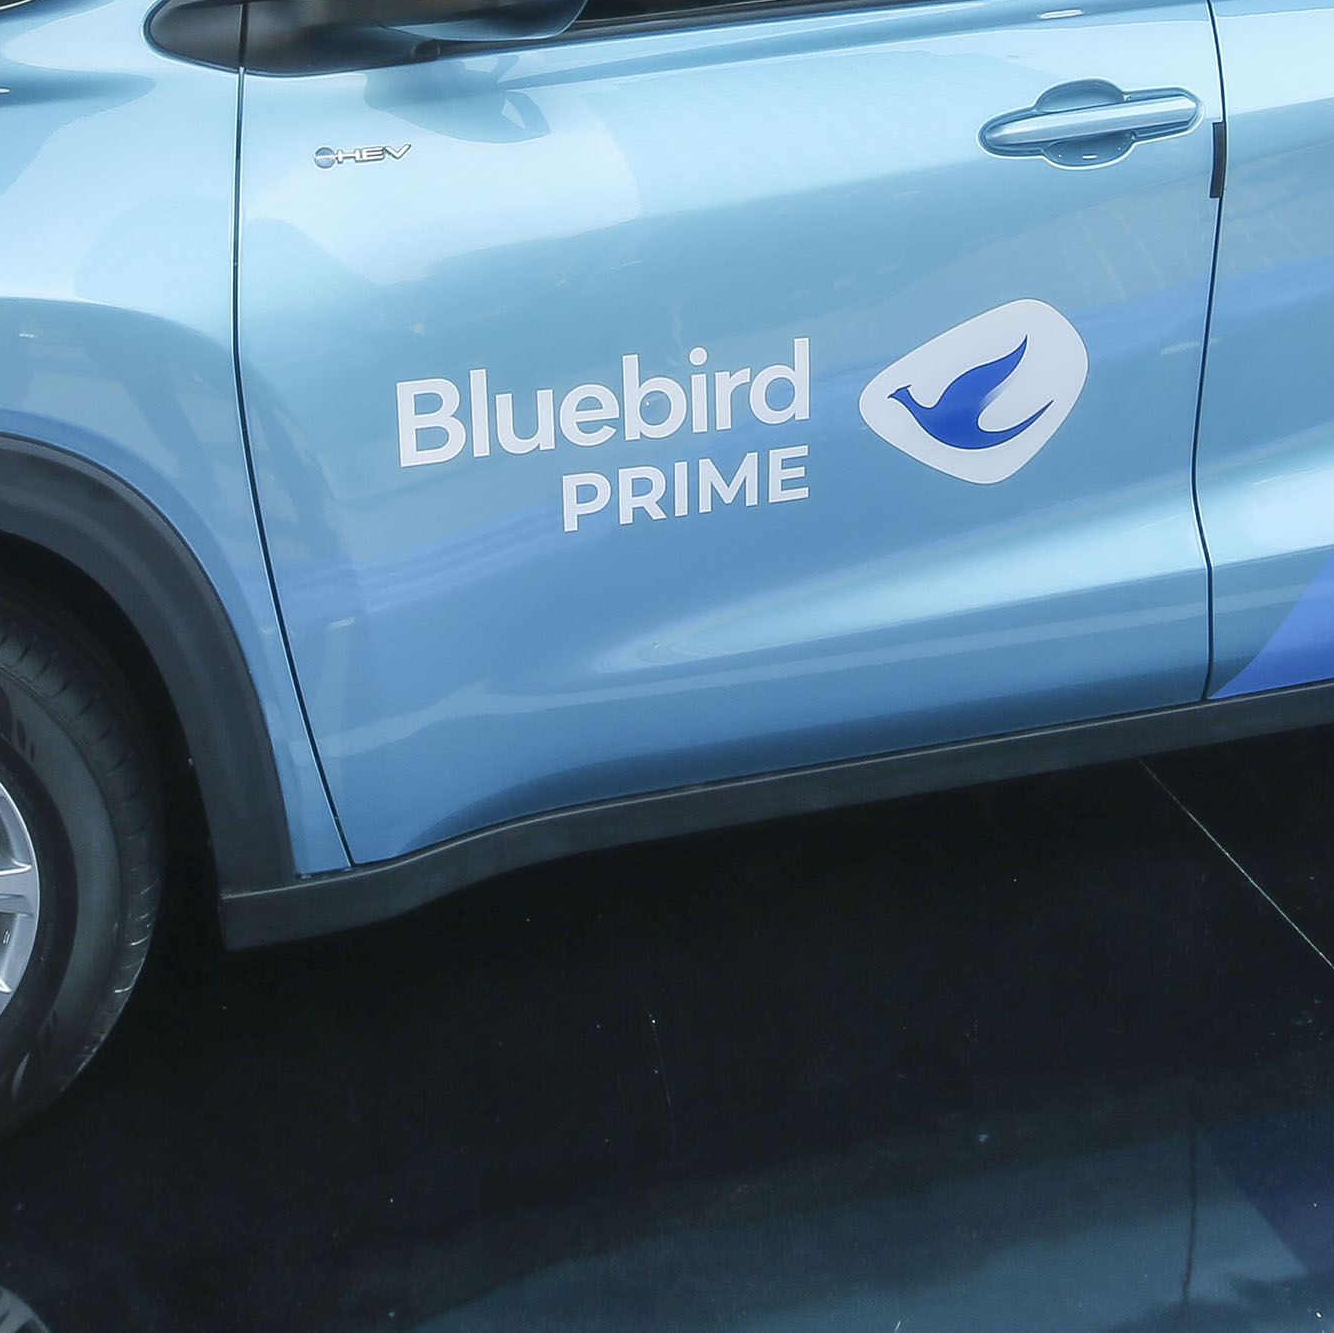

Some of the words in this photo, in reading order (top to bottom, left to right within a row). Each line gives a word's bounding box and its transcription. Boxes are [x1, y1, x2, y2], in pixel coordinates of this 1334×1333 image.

[336, 142, 412, 165] HEV
[395, 337, 811, 469] Bluebird
[560, 444, 811, 533] PRIME
